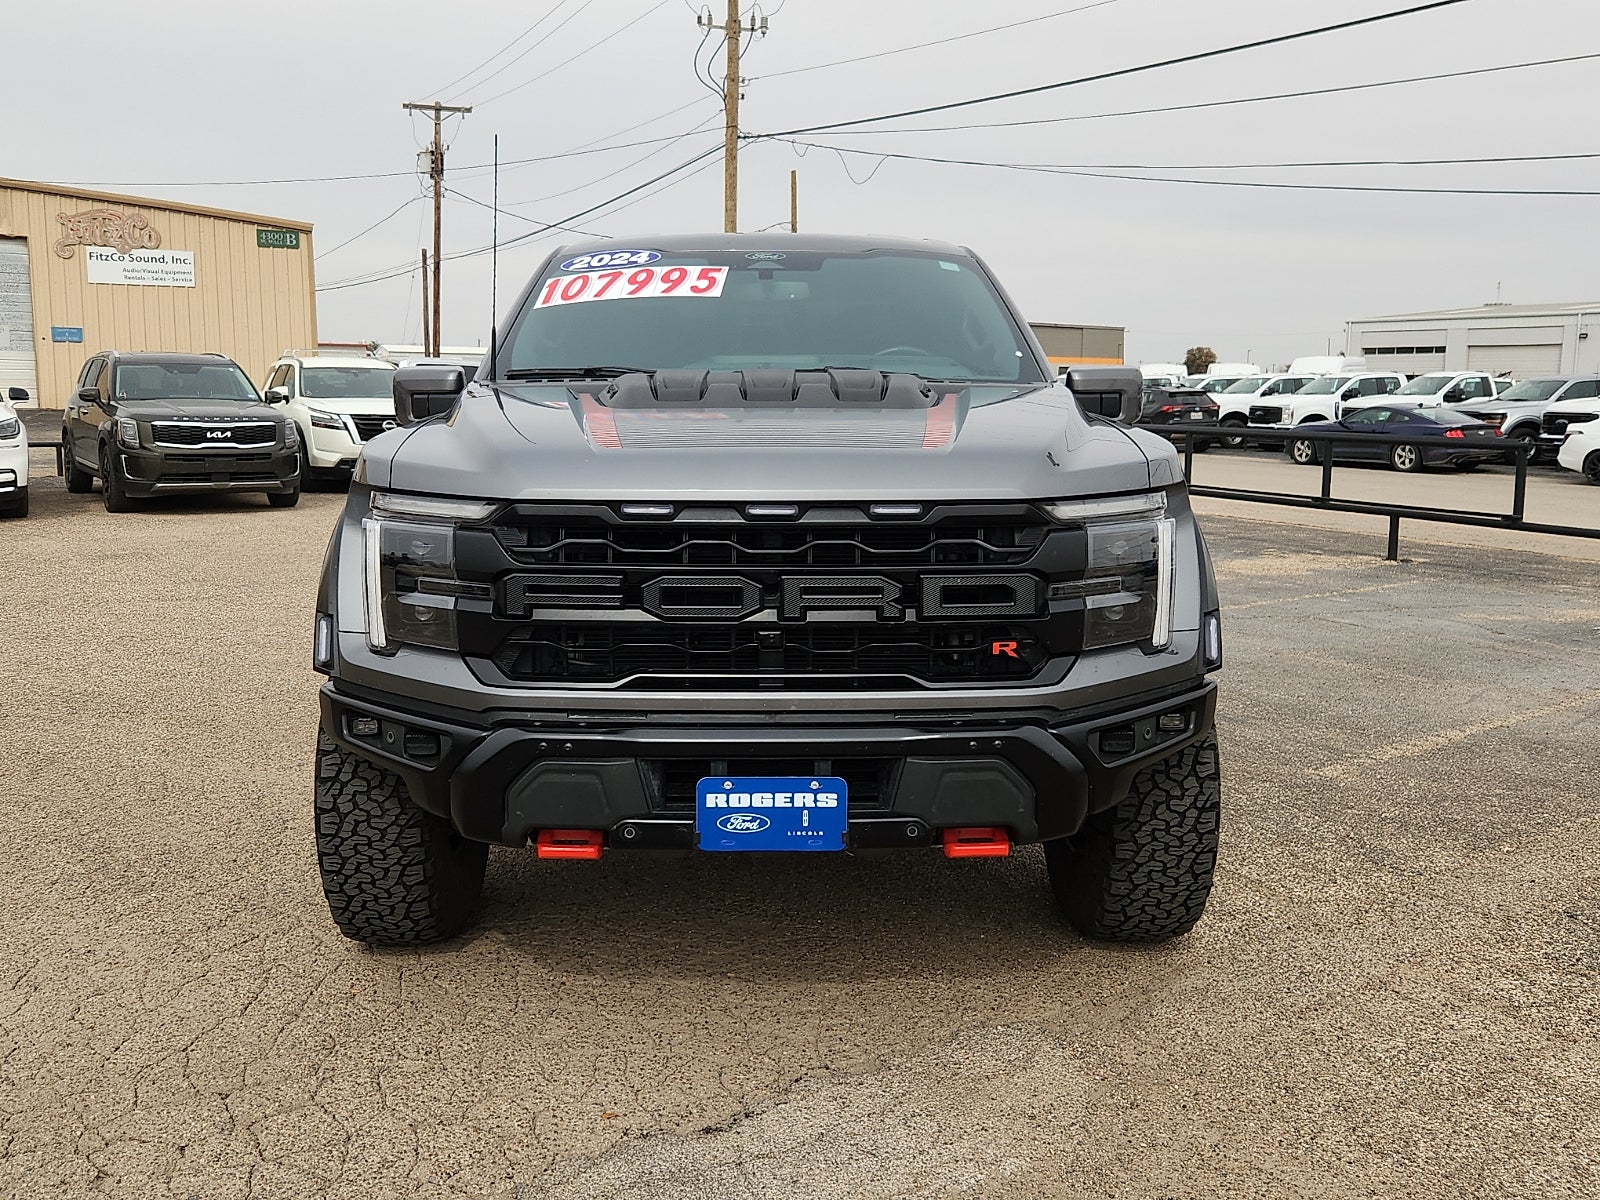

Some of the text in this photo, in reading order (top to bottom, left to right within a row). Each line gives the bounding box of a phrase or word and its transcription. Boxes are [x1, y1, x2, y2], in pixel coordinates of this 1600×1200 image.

[260, 231, 283, 241] 4300
[286, 233, 297, 246] B
[88, 251, 192, 265] FitzCo Sound, Inc.
[570, 251, 651, 269] 2024
[540, 266, 723, 305] 107995
[502, 572, 1046, 621] FORD
[992, 639, 1019, 658] R
[705, 792, 838, 808] ROGERS
